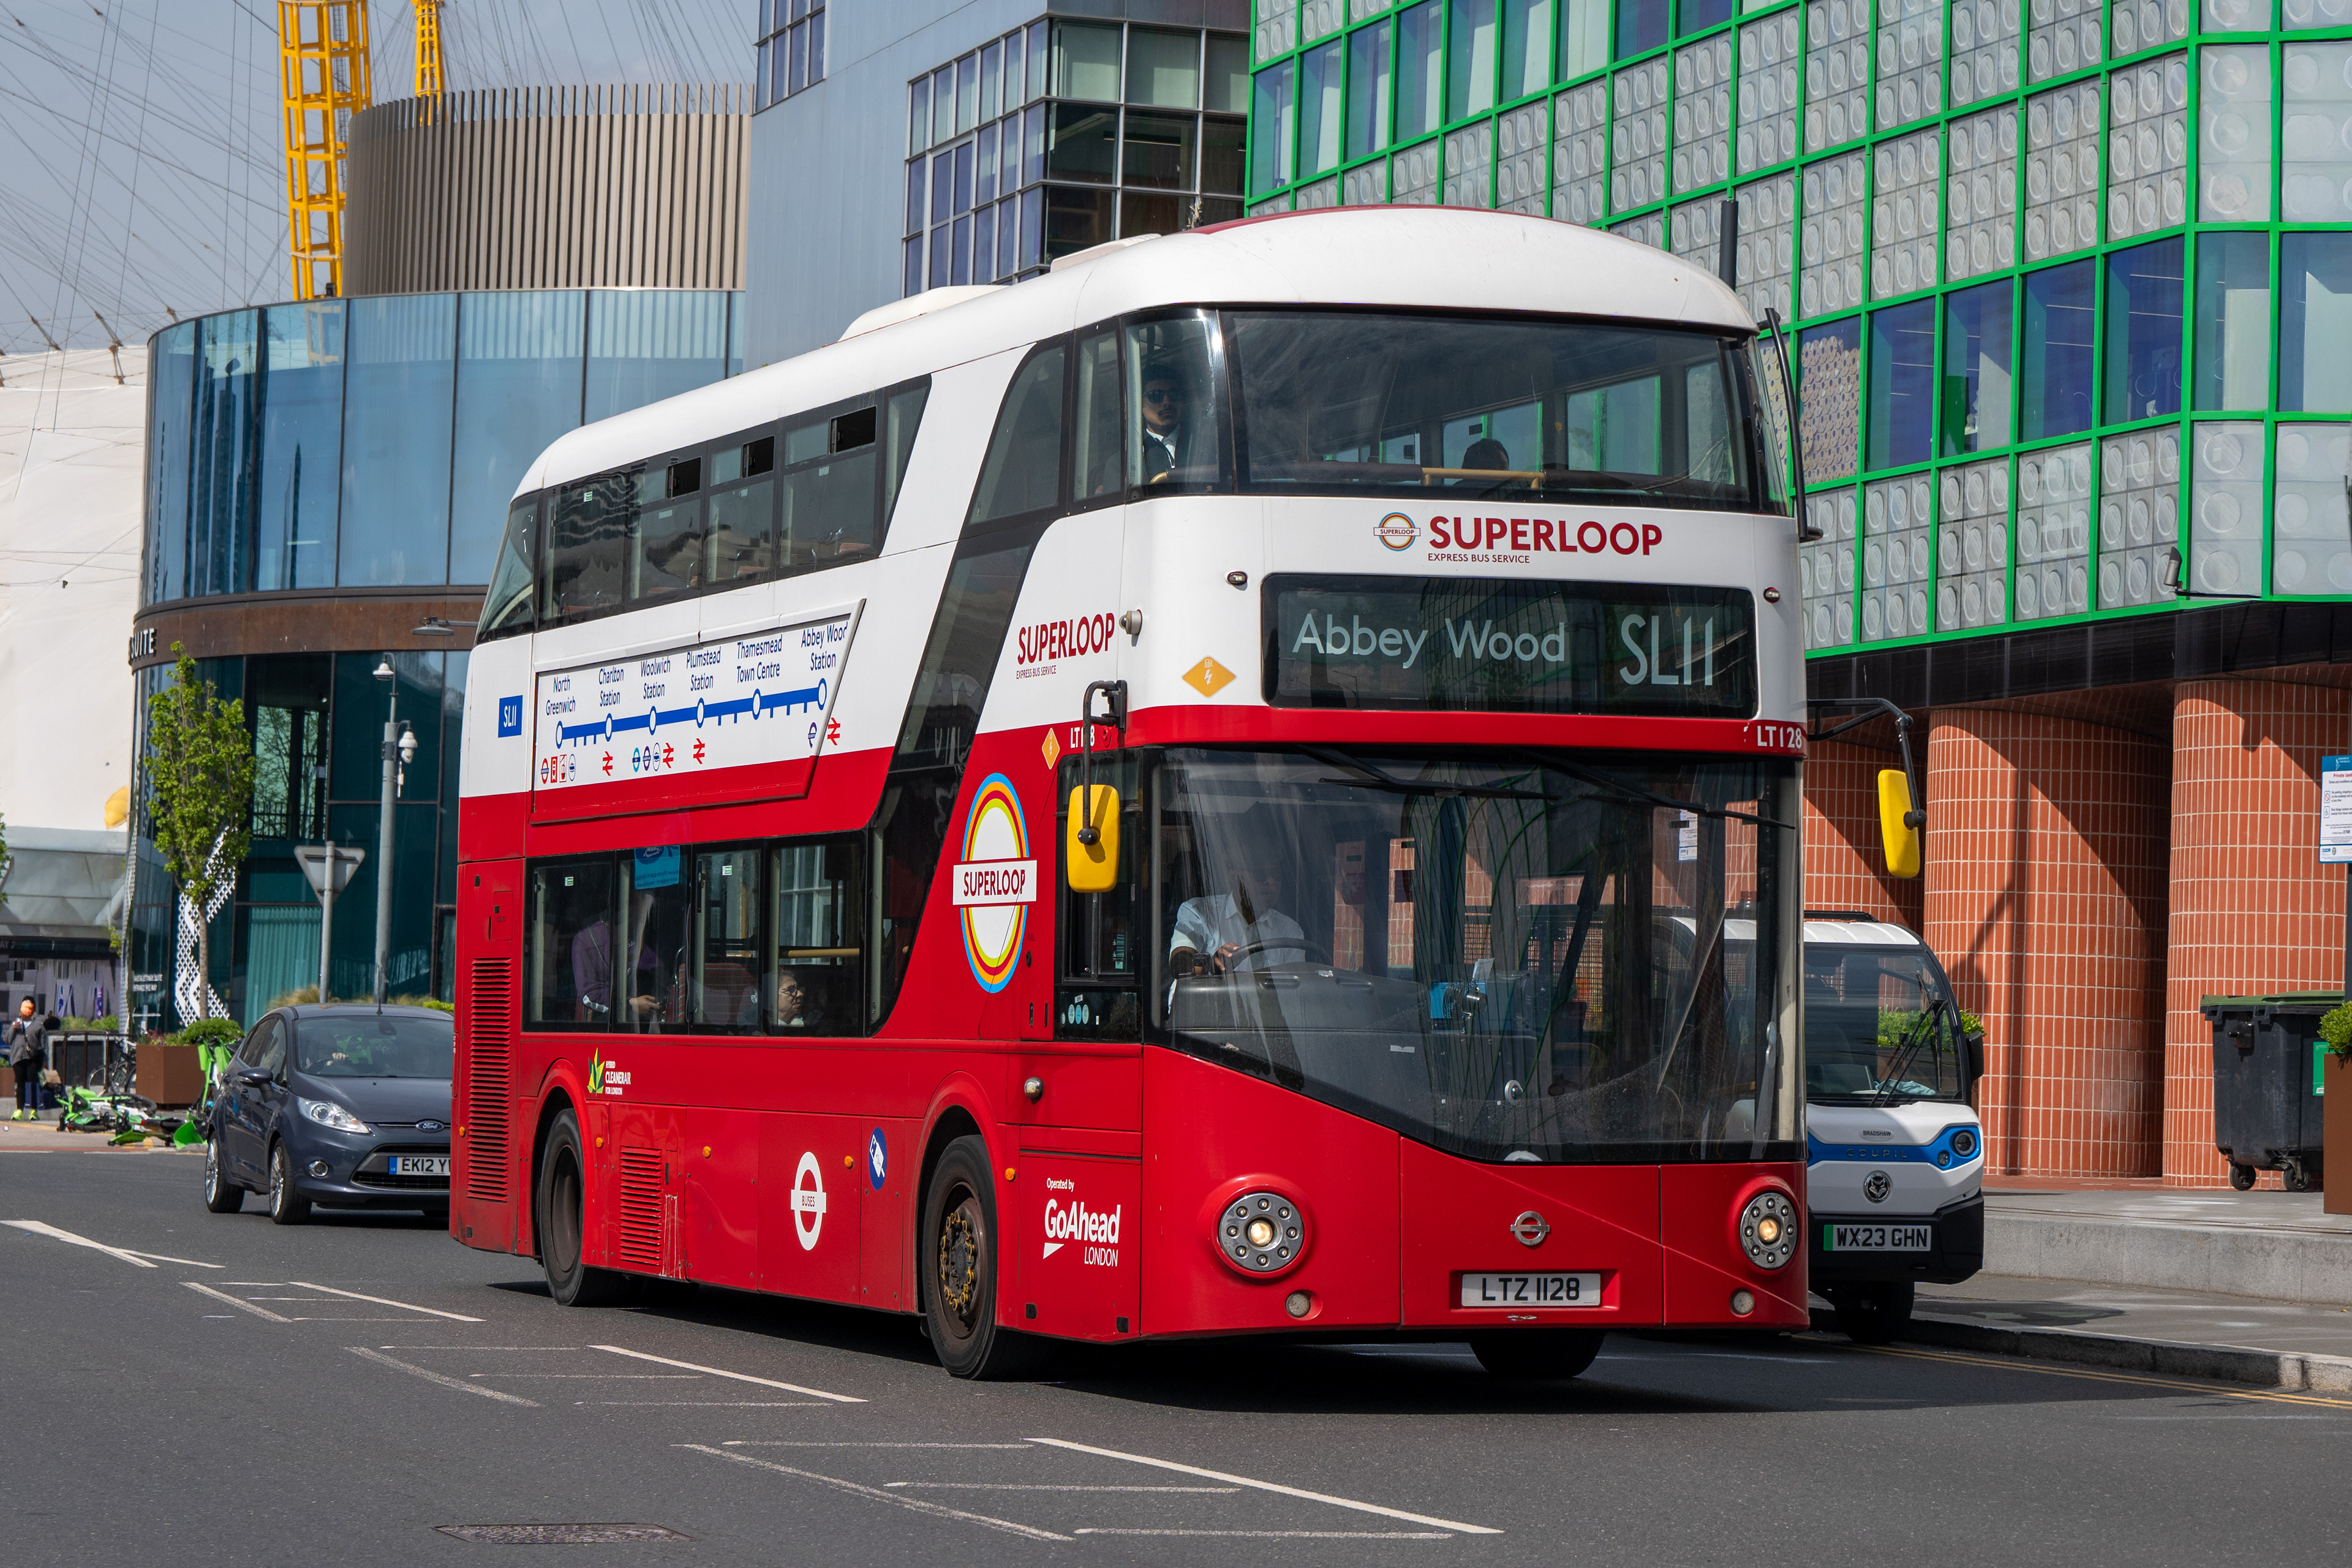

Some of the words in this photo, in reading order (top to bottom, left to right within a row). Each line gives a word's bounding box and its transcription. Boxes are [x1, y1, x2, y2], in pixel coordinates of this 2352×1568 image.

[1429, 516, 1662, 556] SUPERLOOP
[1428, 553, 1468, 562] EXPRESS
[1471, 554, 1489, 562] BUS
[1492, 554, 1530, 564] SERVICE
[737, 635, 782, 660] Thamesmead
[801, 628, 825, 649] Abbey
[1017, 612, 1115, 665] SUPERLOOP
[686, 646, 722, 669] Plumstead
[1292, 613, 1428, 669] Abbey
[1445, 619, 1565, 662] Wood
[1619, 614, 1713, 686] SL11
[640, 656, 671, 677] Woolwich
[810, 650, 836, 671] Station
[598, 666, 624, 685] Charlton
[690, 673, 714, 692] Station
[737, 666, 755, 684] Town
[756, 662, 780, 680] Centre
[1016, 668, 1032, 679] EXPRESS
[1041, 665, 1057, 676] SERVICE
[553, 675, 571, 693] North
[643, 681, 665, 700] Station
[546, 696, 576, 715] Greenwich
[600, 690, 620, 707] Station
[503, 704, 517, 728] SL11
[1070, 725, 1095, 748] LT18
[1757, 725, 1802, 749] LT128
[963, 869, 1025, 897] SUPERLOOP
[611, 1087, 623, 1095] LONDON
[1847, 1148, 1907, 1158] GOUPIL
[402, 1158, 434, 1172] EK12
[1046, 1177, 1068, 1191] Operated
[1068, 1179, 1075, 1192] by
[802, 1195, 815, 1207] BUSES
[1044, 1199, 1121, 1244] GoAhead
[1836, 1227, 1885, 1247] WX23
[1891, 1228, 1928, 1247] GHN
[1084, 1246, 1118, 1267] LONDON
[1482, 1277, 1529, 1301] LTZ
[1536, 1277, 1580, 1301] 1128
